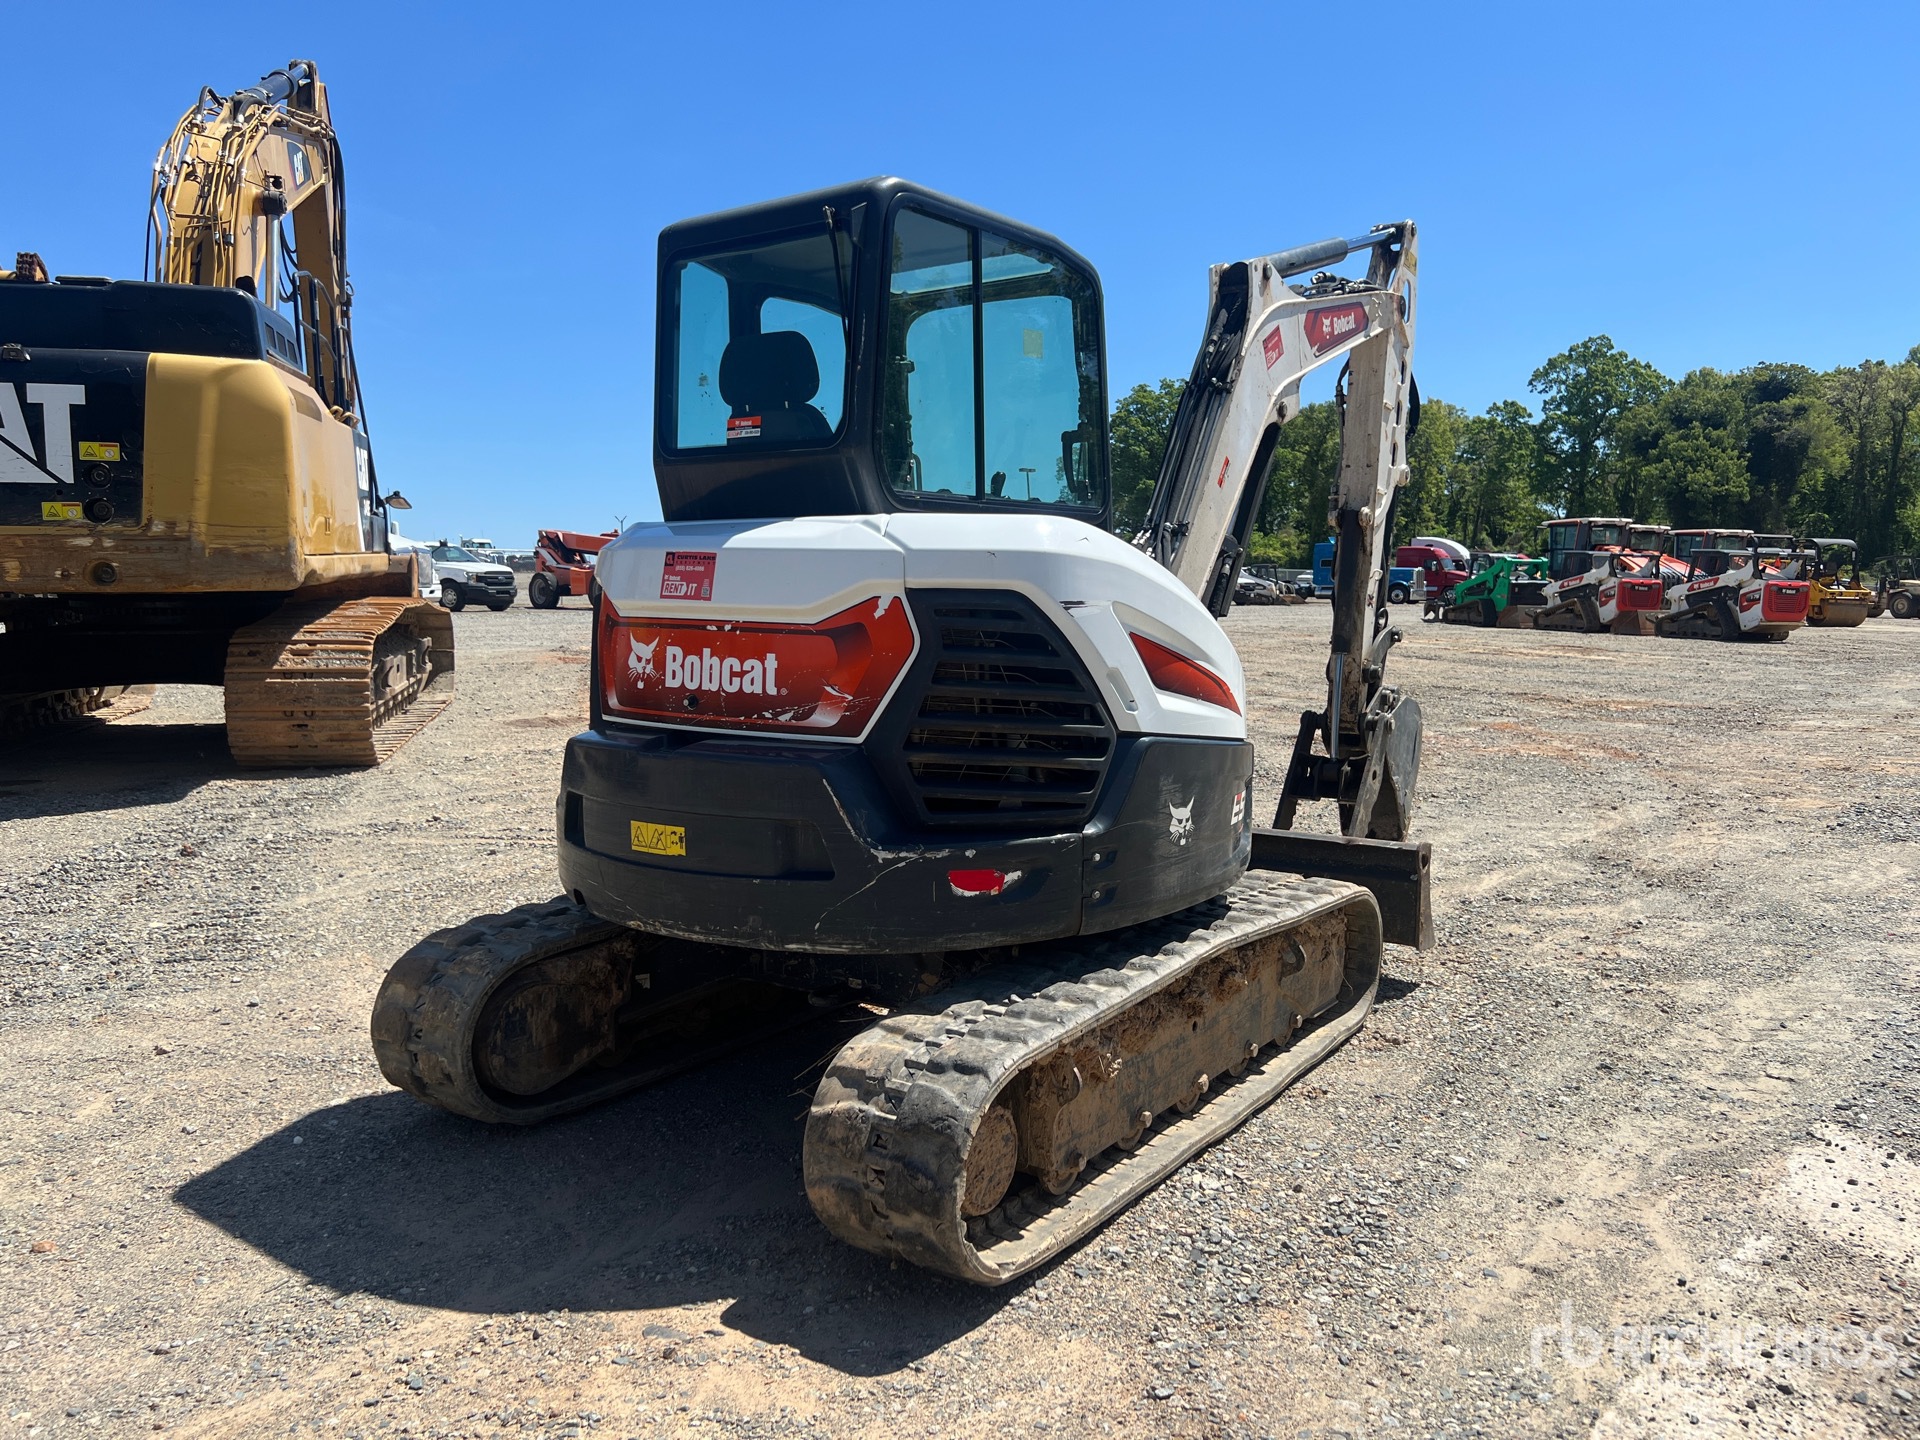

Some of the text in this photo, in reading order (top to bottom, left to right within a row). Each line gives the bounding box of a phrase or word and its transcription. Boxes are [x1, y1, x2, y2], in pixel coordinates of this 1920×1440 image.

[1333, 312, 1355, 335] Bobcat
[664, 583, 697, 596] RENT IT
[665, 645, 778, 695] Bobcat
